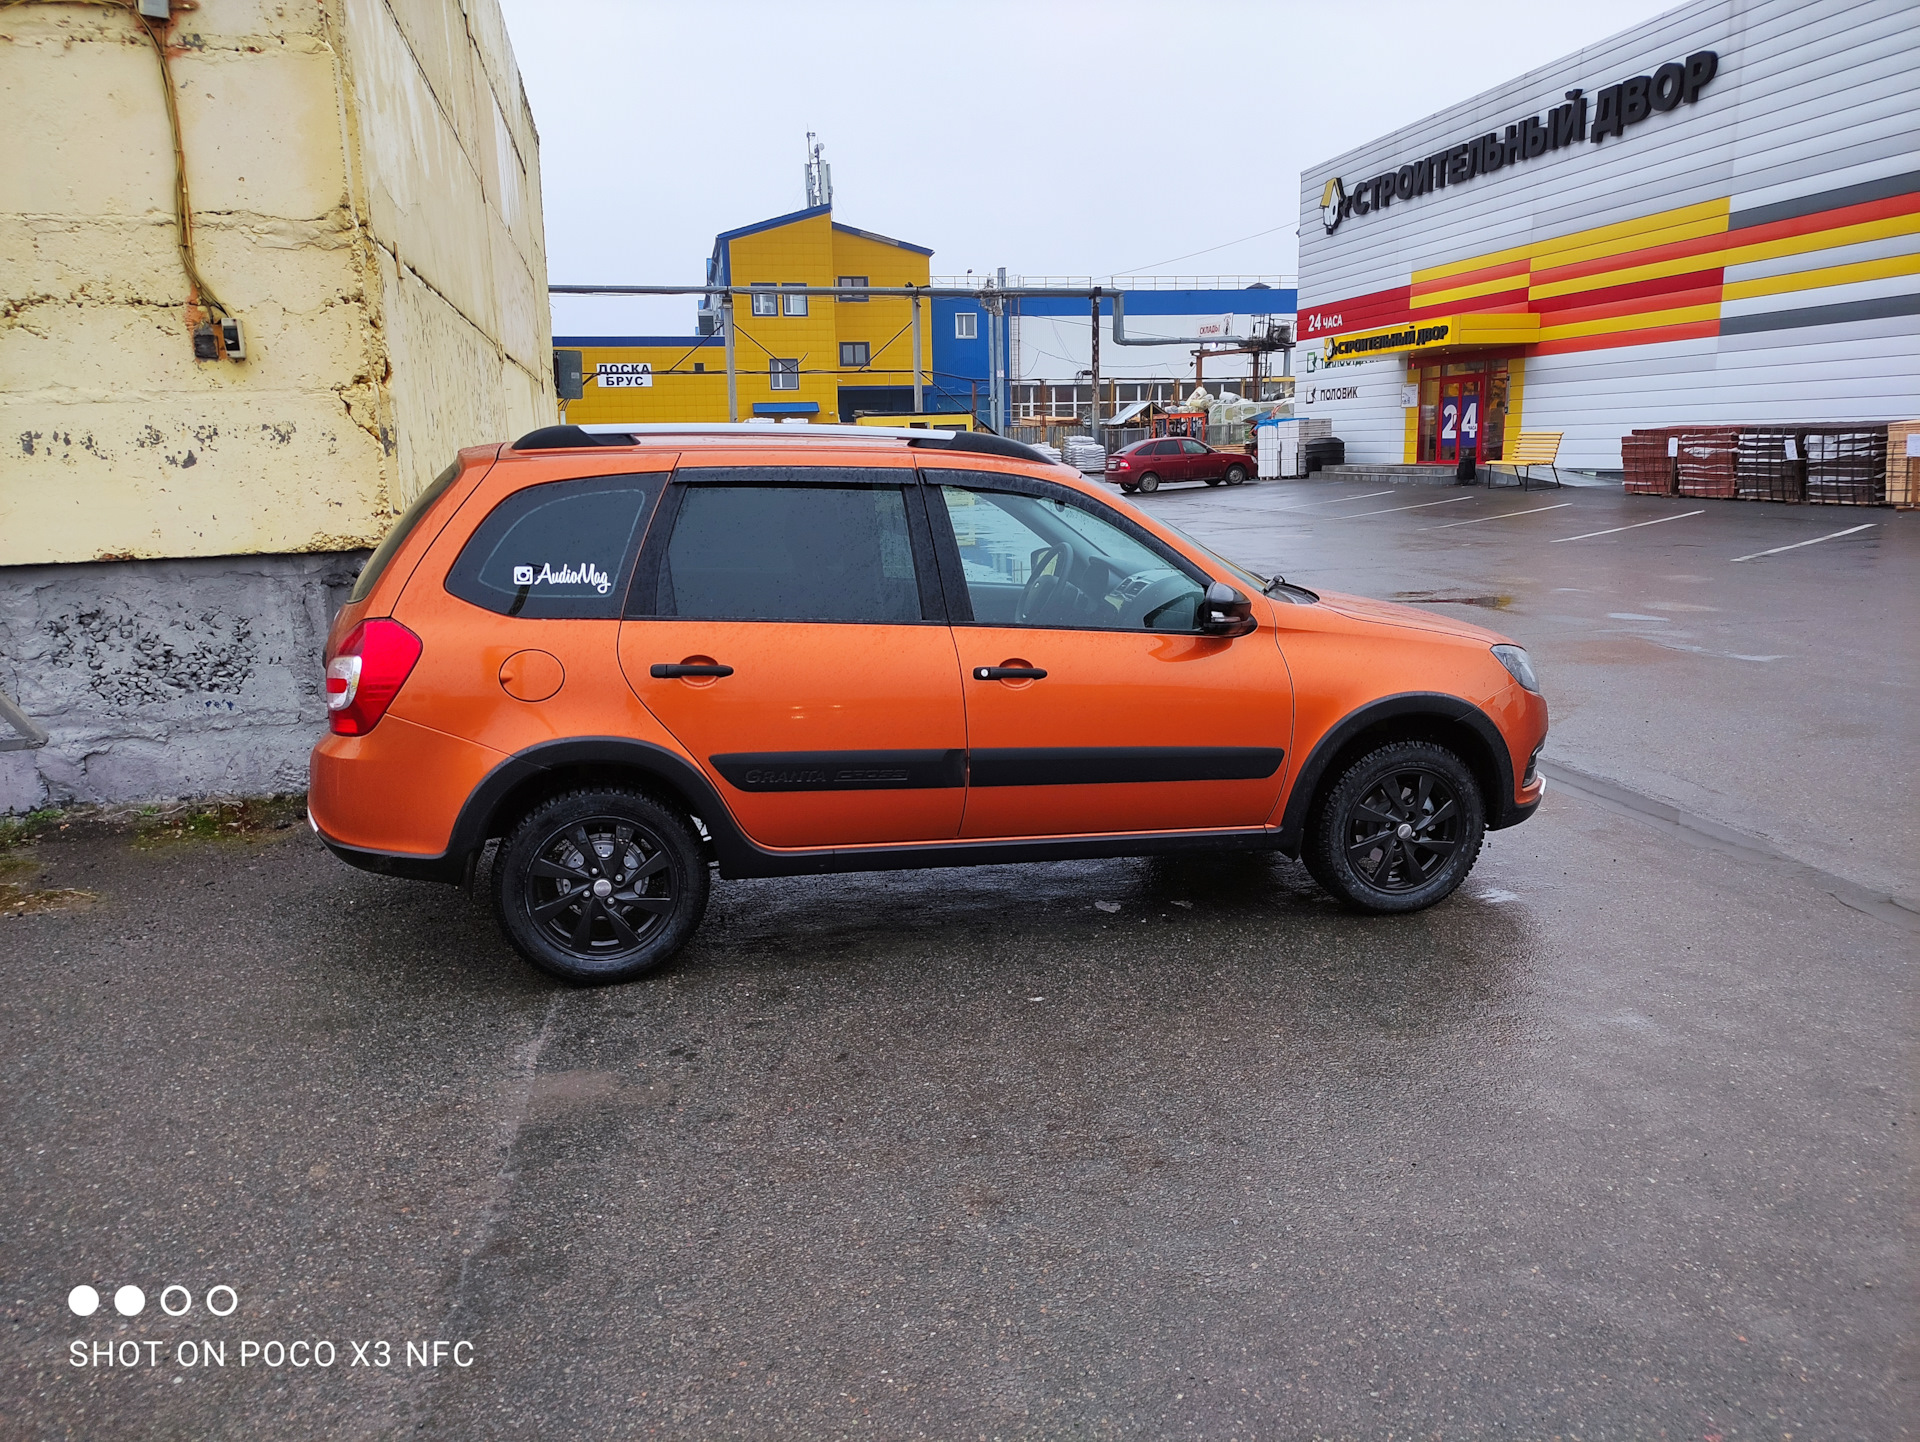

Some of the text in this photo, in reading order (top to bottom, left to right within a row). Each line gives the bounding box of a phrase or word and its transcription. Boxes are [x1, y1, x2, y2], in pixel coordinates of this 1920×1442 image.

[1352, 50, 1719, 216] СТРОИТЕЛЬНЫЙ ДВОР
[1308, 313, 1343, 332] 24 ЧАСА
[1338, 325, 1449, 355] СТРОИТЕЛЬНЫЙ ДВОР
[599, 364, 650, 376] ДОСКА
[605, 376, 644, 386] БРУС
[1320, 386, 1359, 401] ПОЛОВИК
[1442, 403, 1478, 439] 24
[534, 562, 612, 594] AudioMag
